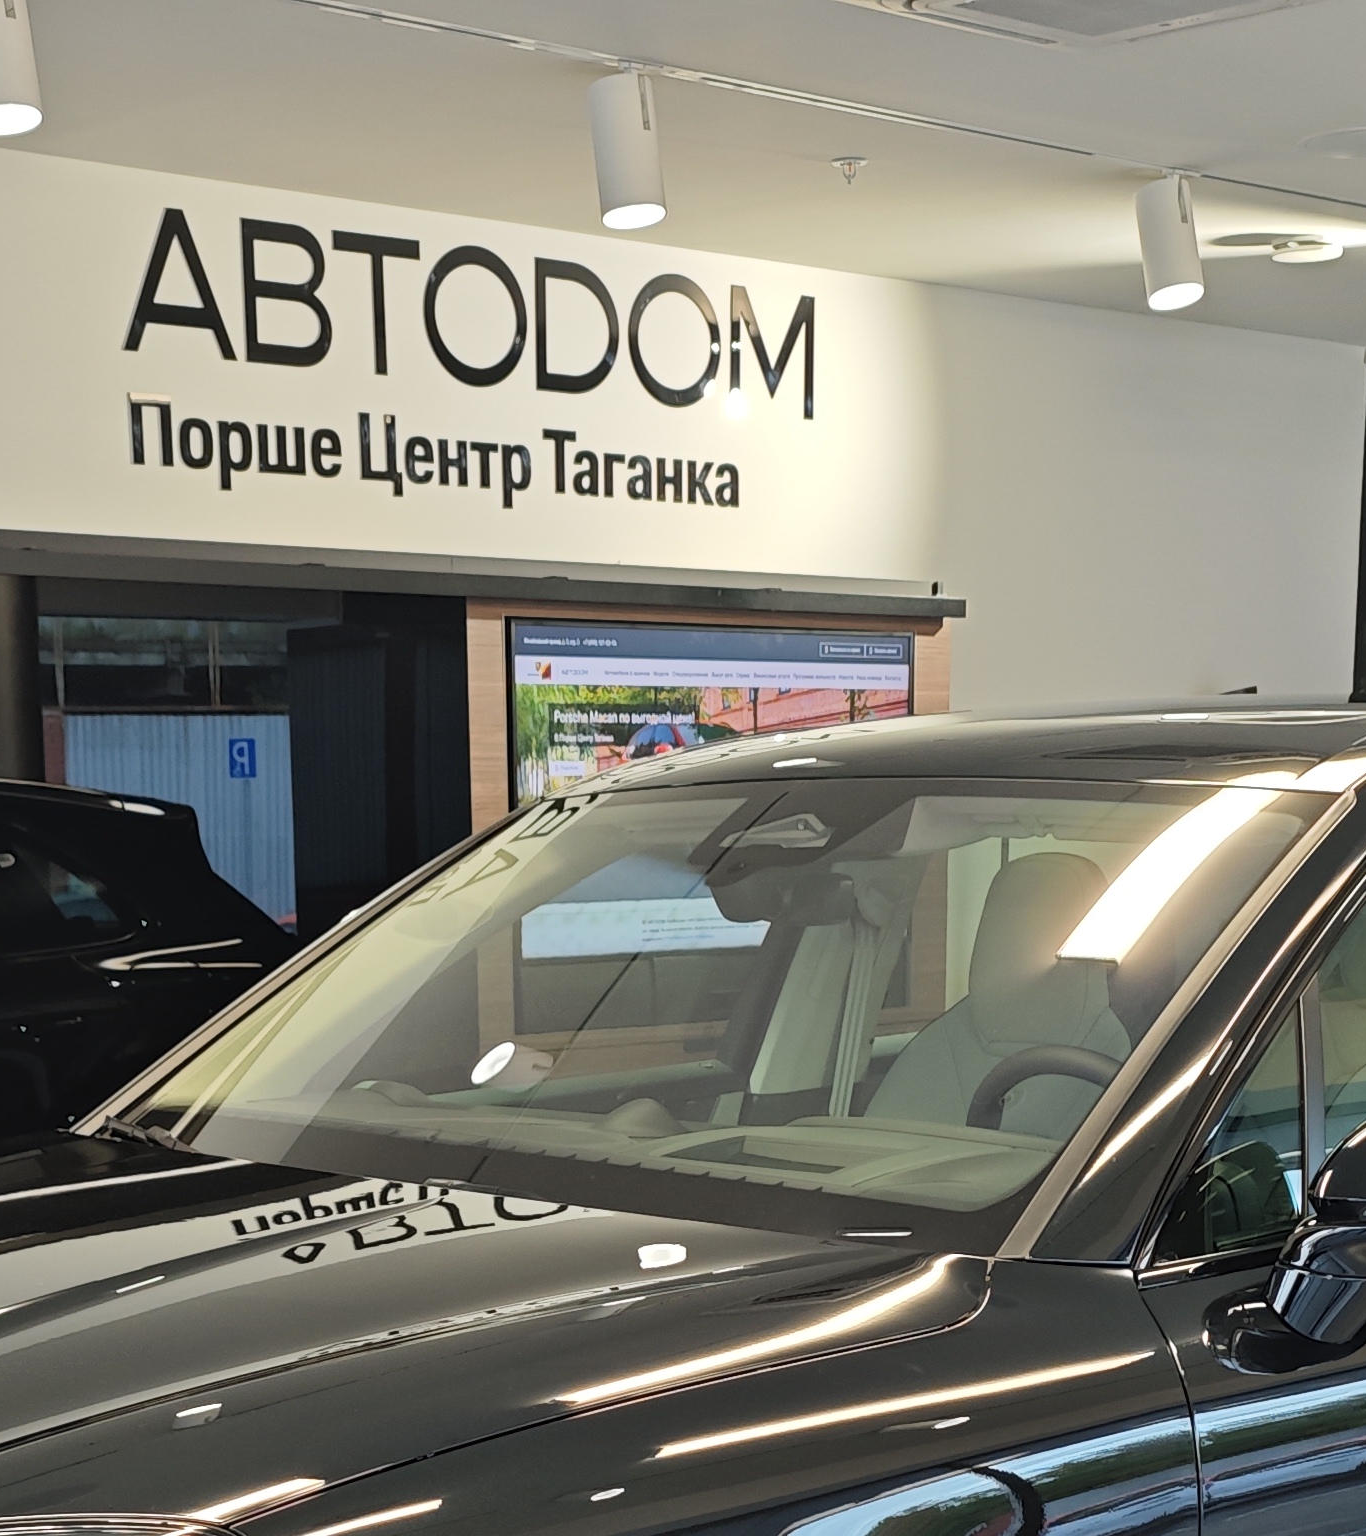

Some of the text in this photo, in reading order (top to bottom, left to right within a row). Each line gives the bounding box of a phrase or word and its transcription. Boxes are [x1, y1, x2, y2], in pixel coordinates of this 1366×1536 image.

[128, 392, 740, 508] Порше Центр Таганка
